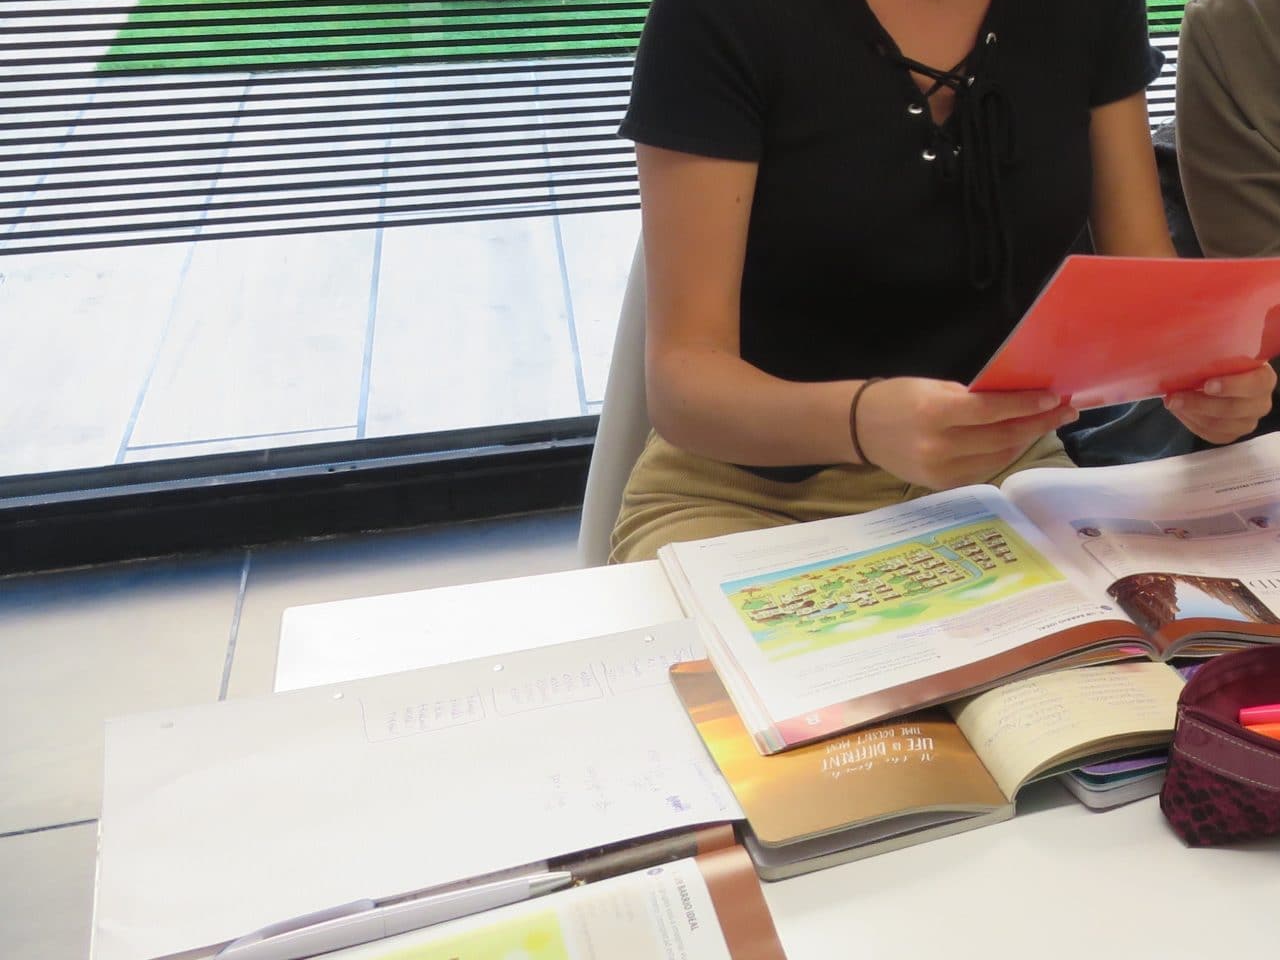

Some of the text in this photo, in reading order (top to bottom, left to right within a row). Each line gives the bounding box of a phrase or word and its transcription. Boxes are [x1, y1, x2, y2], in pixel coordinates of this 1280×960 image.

[857, 728, 895, 745] DOESN'T
[901, 727, 921, 736] TIME
[906, 737, 934, 752] LIFE
[686, 910, 701, 932] IDEAL
